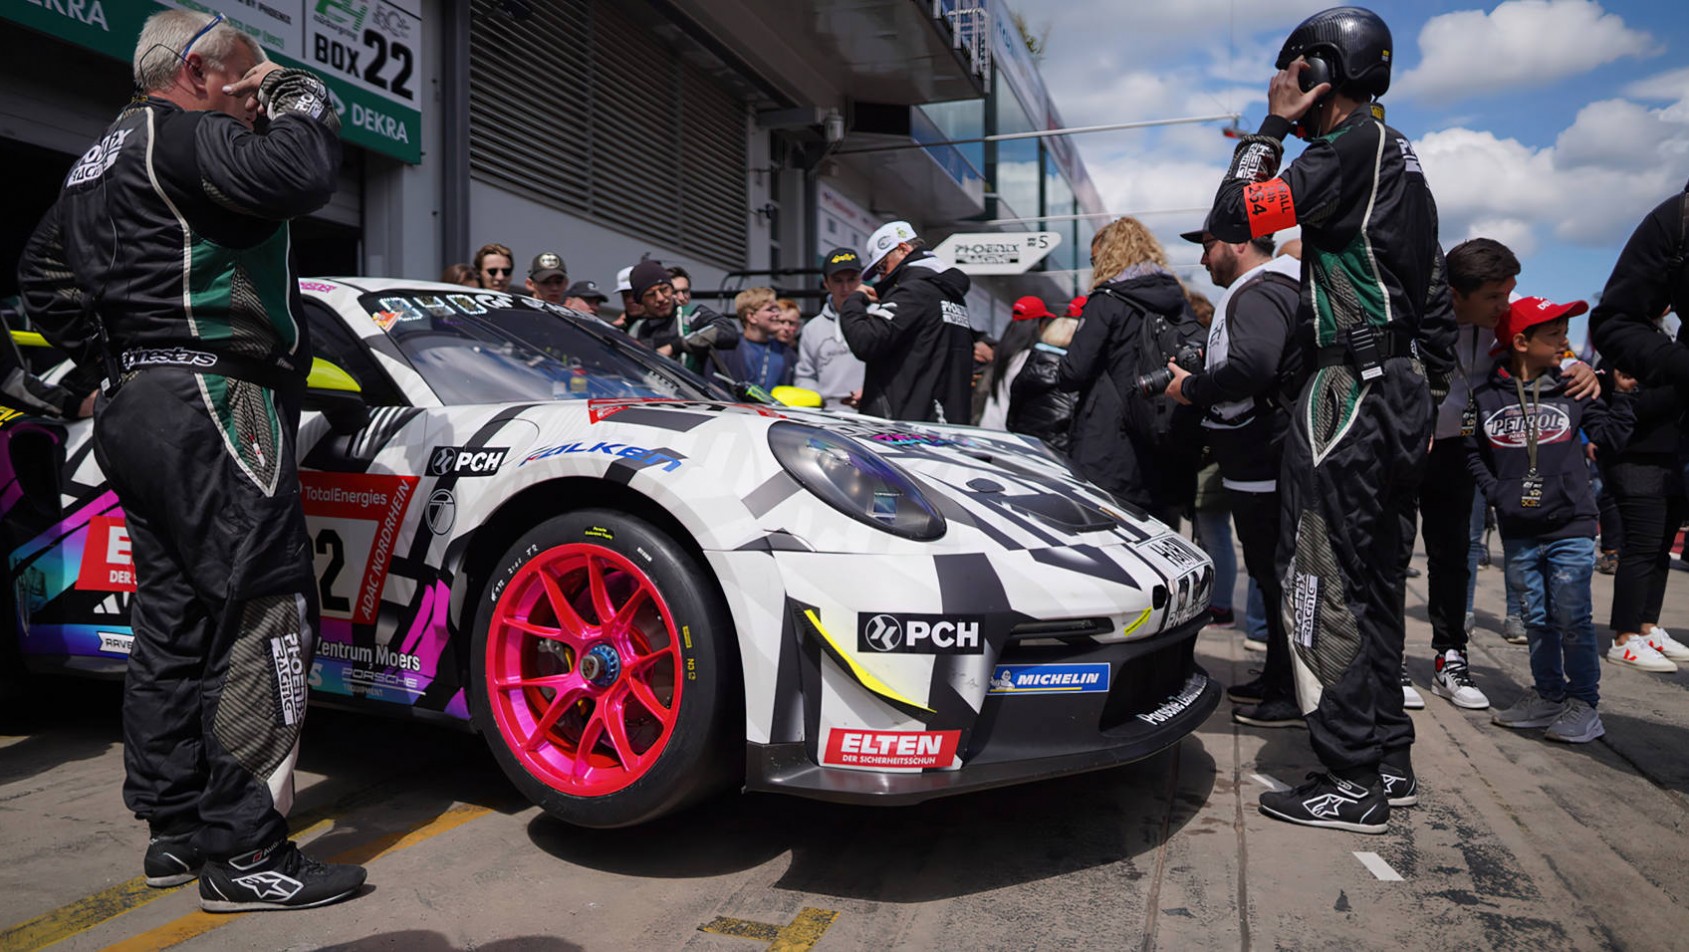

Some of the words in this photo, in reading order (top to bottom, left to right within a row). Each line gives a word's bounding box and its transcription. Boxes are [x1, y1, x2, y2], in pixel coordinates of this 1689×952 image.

[314, 32, 360, 79] BOX
[363, 28, 414, 101] 22
[351, 103, 409, 144] DEKRA
[1491, 413, 1561, 436] PETROL
[454, 451, 504, 472] PCH
[519, 441, 682, 473] FALKEN
[305, 486, 388, 508] TotalEnergies
[361, 574, 380, 621] ADAC
[371, 479, 411, 578] NORDRHEIN
[109, 570, 131, 584] DER
[308, 528, 351, 612] 2
[105, 637, 133, 650] RAVE
[905, 620, 979, 649] PCH
[375, 645, 421, 672] Moers
[275, 649, 294, 712] RACING
[284, 632, 305, 721] PHOENIX
[342, 667, 418, 689] PORSCHE
[1016, 672, 1099, 686] MICHELIN
[1135, 702, 1185, 725] Porsche
[841, 732, 943, 756] ELTEN
[842, 754, 858, 763] DER
[860, 755, 937, 766] SICHERHEITSSCHUH
